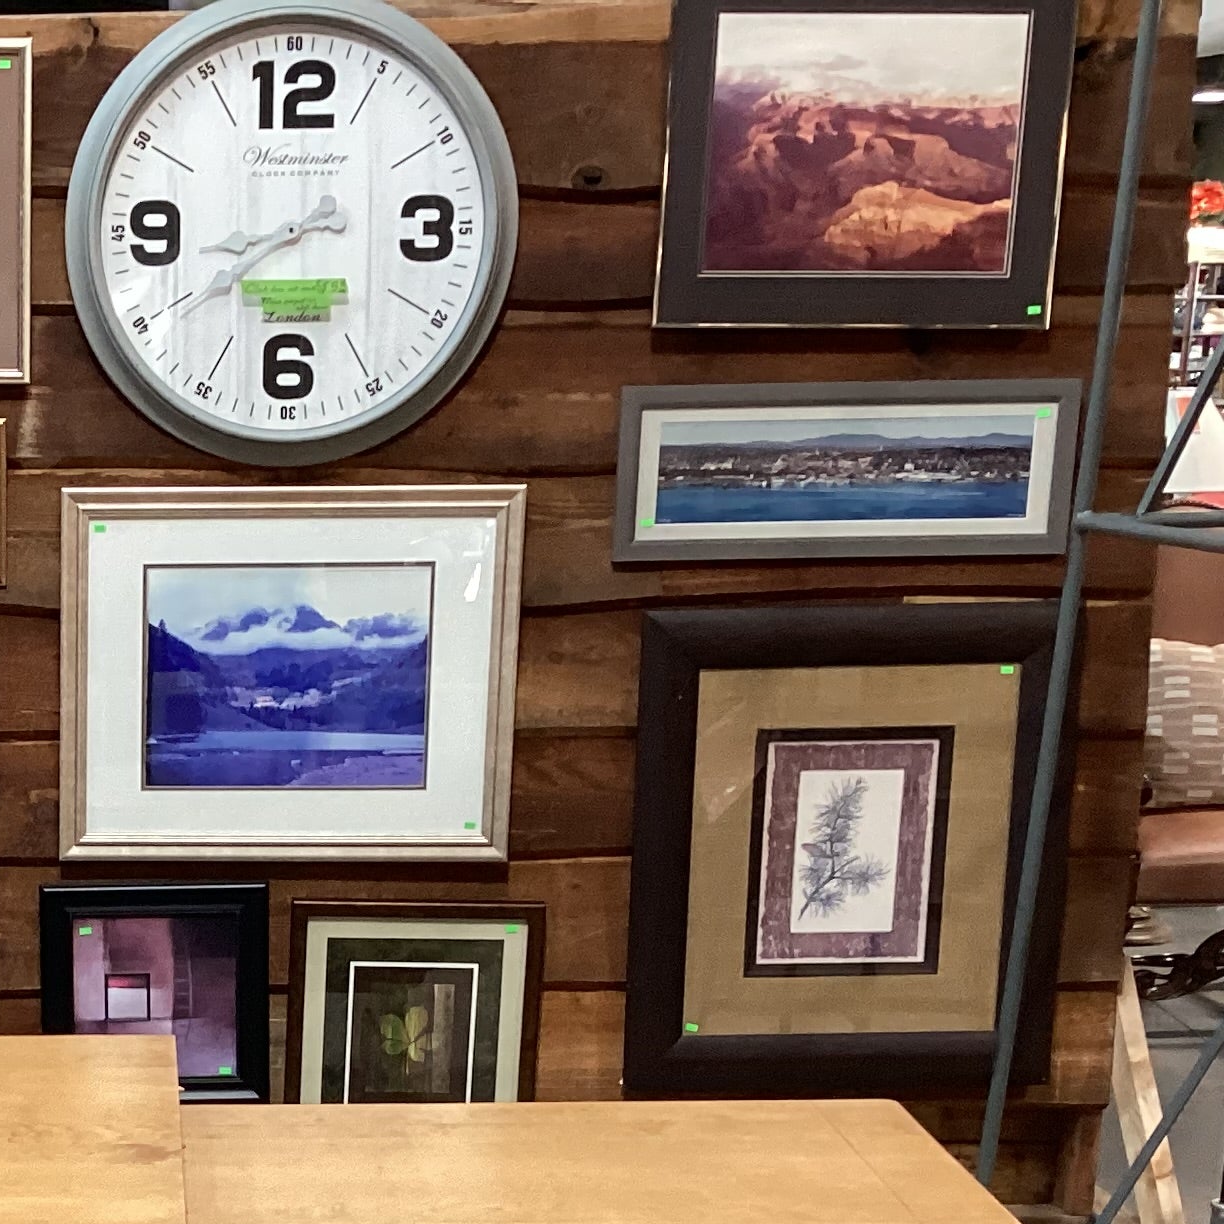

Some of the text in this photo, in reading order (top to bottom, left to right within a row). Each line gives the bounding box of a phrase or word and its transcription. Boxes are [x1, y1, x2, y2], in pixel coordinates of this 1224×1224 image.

[287, 36, 303, 51] 60
[197, 60, 217, 81] 55
[377, 60, 389, 75] 5
[252, 60, 336, 129] 12
[133, 131, 152, 150] 50
[436, 126, 454, 145] 10
[242, 143, 349, 168] Westminster
[251, 169, 340, 178] CLOCK COMPANY
[111, 224, 125, 243] 45
[130, 200, 181, 267] 9
[400, 194, 454, 262] 3
[458, 218, 473, 235] 15
[132, 315, 149, 335] 40
[263, 310, 321, 323] London
[430, 309, 448, 329] 20
[262, 333, 315, 400] 6
[194, 381, 213, 400] 35
[365, 377, 384, 396] 25
[280, 405, 297, 420] 30
